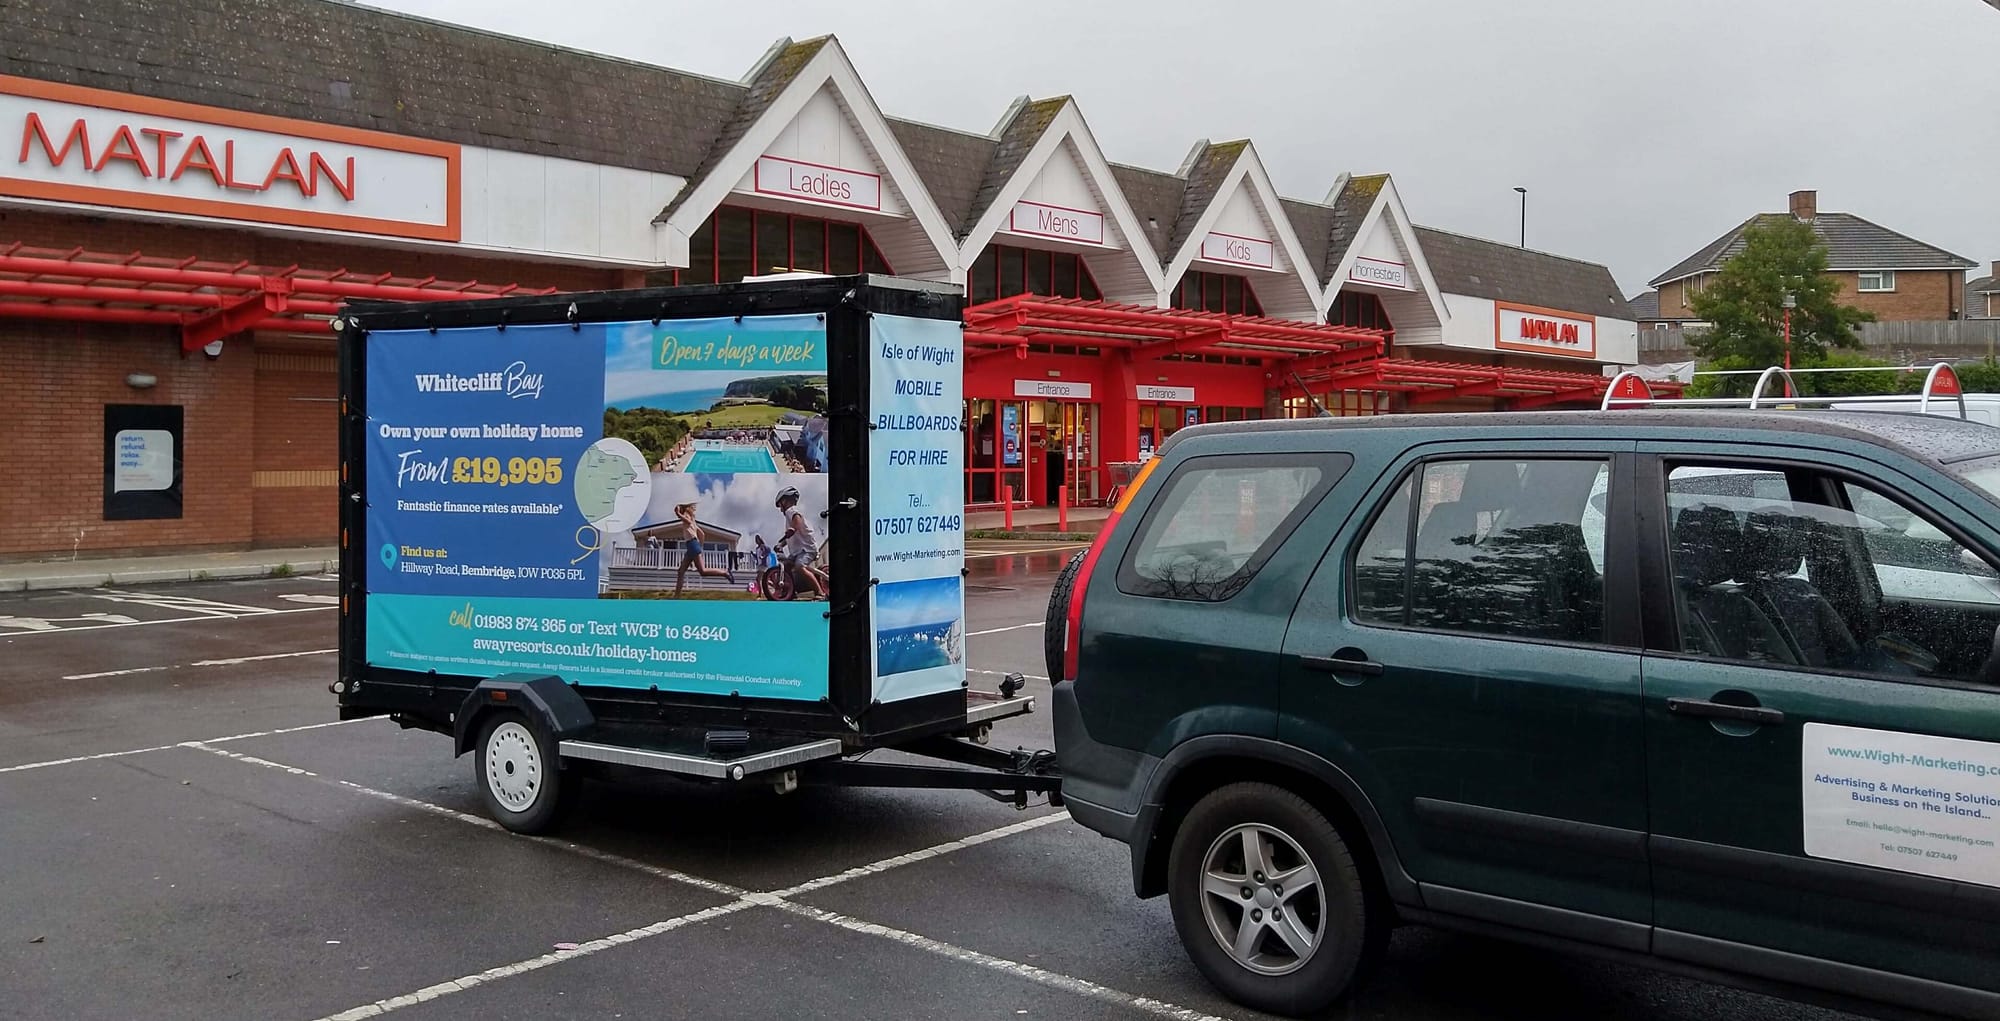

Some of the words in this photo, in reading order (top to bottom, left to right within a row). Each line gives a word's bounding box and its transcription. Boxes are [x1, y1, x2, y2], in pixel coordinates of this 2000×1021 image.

[19, 112, 355, 200] MATALAN
[789, 167, 851, 199] Ladies
[1039, 209, 1078, 235] Mens
[1226, 240, 1251, 261] Kids
[1521, 317, 1578, 344] MATALAN
[660, 336, 702, 366] Open
[704, 343, 715, 361] 7
[717, 335, 758, 368] days
[759, 347, 768, 360] a
[772, 341, 815, 364] week
[882, 343, 904, 360] Isle
[907, 346, 919, 361] of
[922, 346, 954, 366] Wight
[416, 373, 503, 393] Whitecliff
[503, 361, 544, 399] Bay
[895, 379, 943, 396] MOBILE
[1037, 383, 1070, 396] Entrance
[1147, 387, 1176, 399] Entrance
[380, 424, 412, 438] Own
[413, 427, 447, 441] your
[450, 427, 480, 438] own
[483, 424, 538, 441] holiday
[541, 424, 583, 438] home
[878, 414, 957, 431] BILLBOARDS
[889, 450, 915, 465] FOR
[919, 450, 948, 465] HIRE
[398, 450, 448, 488] From
[452, 457, 562, 487] £19,995
[397, 501, 442, 512] Fantastic
[443, 502, 480, 514] finance
[482, 504, 509, 514] rates
[908, 494, 930, 508] Tel...
[875, 518, 913, 536] 07507
[917, 515, 960, 533] 627449
[401, 546, 422, 557] Find
[423, 549, 434, 558] us
[436, 550, 448, 558] at:
[875, 549, 960, 562] www.Wight-Marketing.com
[401, 562, 434, 576] Hillway
[435, 564, 460, 576] Road,
[461, 565, 517, 579] Bembridge,
[518, 568, 538, 578] IOW
[567, 569, 586, 581] 5PL
[449, 602, 474, 630] call
[474, 614, 513, 630] 01983
[515, 616, 538, 631] 874
[541, 618, 566, 633] 365
[569, 623, 585, 634] or
[588, 621, 617, 636] Text
[665, 625, 679, 638] to
[682, 625, 729, 641] 84840
[473, 637, 697, 662] awayresorts.co.uk/holiday-homes
[1828, 746, 2000, 776] www.Wight-Marketing.c
[1814, 773, 1875, 792] Advertising
[1879, 782, 1889, 792] &
[1892, 783, 1950, 802] Marketing
[1852, 791, 1899, 807] Business
[1903, 800, 1918, 809] on
[1922, 800, 1941, 812] the
[1945, 804, 1991, 819] Island...
[1846, 818, 1871, 829] Email:
[1897, 845, 1923, 857] 07507
